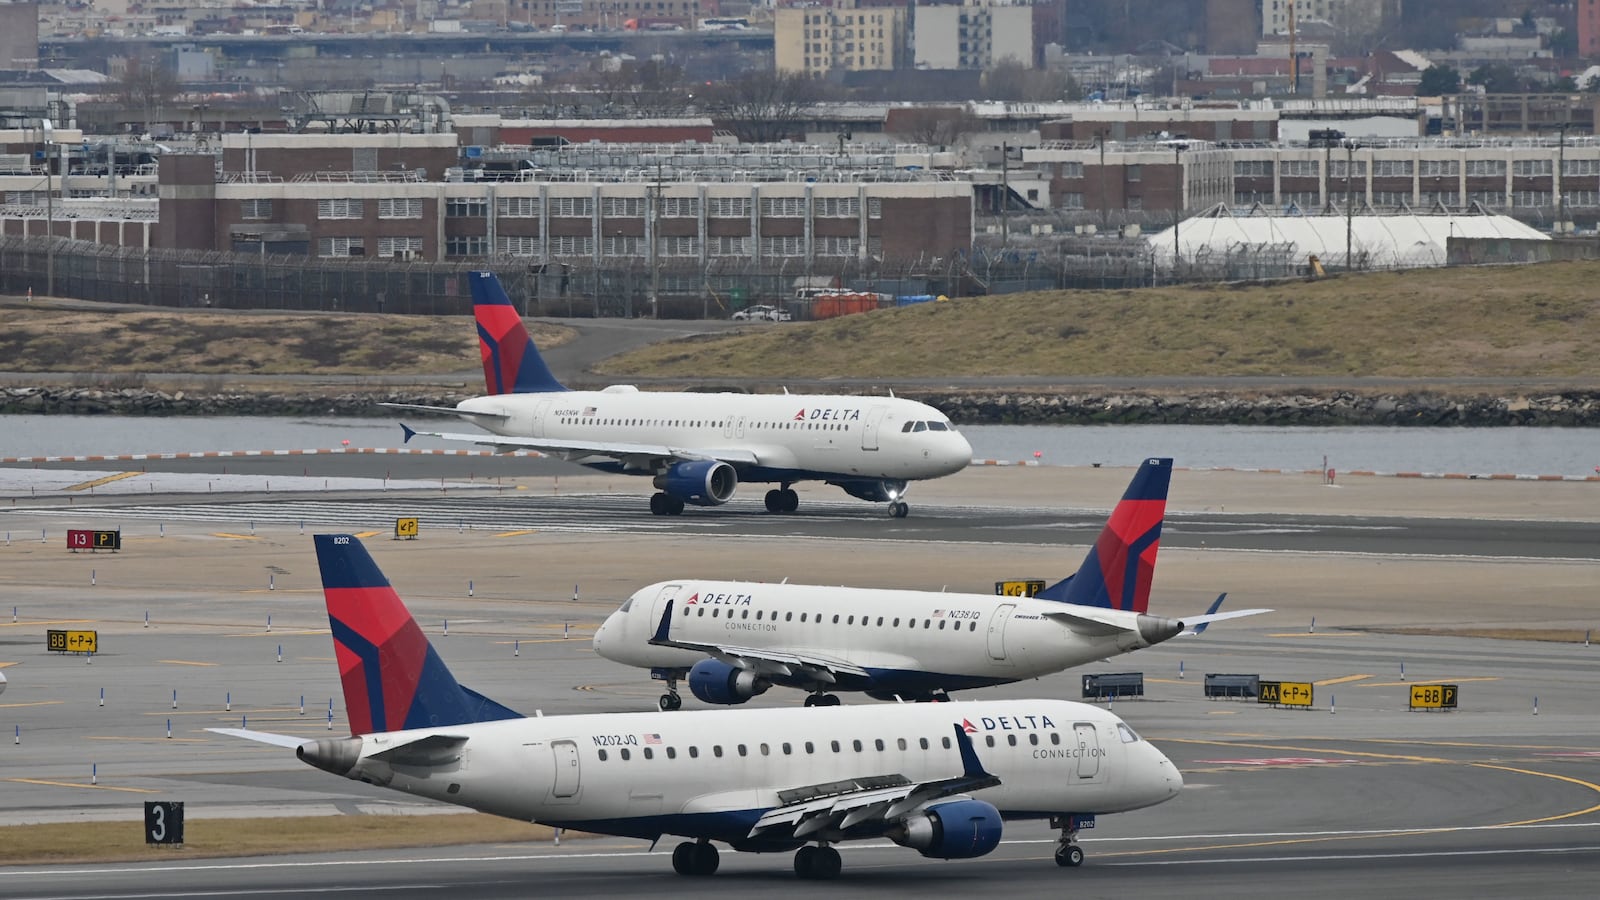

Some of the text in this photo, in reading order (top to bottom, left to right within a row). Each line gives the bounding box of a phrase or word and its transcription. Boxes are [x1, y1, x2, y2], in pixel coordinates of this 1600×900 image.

[810, 408, 860, 421] DELTA
[407, 521, 414, 532] P
[74, 533, 108, 546] 13 P
[333, 537, 350, 545] 8202
[1032, 584, 1038, 598] P
[702, 593, 752, 606] DELTA
[948, 610, 981, 620] N238JQ
[725, 622, 777, 632] CONNECTION
[51, 634, 85, 648] BB P
[1262, 686, 1299, 700] AA P
[1424, 689, 1453, 704] BB P
[981, 715, 1056, 731] DELTA
[592, 734, 638, 746] N202JQ
[1032, 748, 1106, 759] CONNECTION
[151, 805, 166, 841] 3
[1079, 820, 1094, 829] 8202
